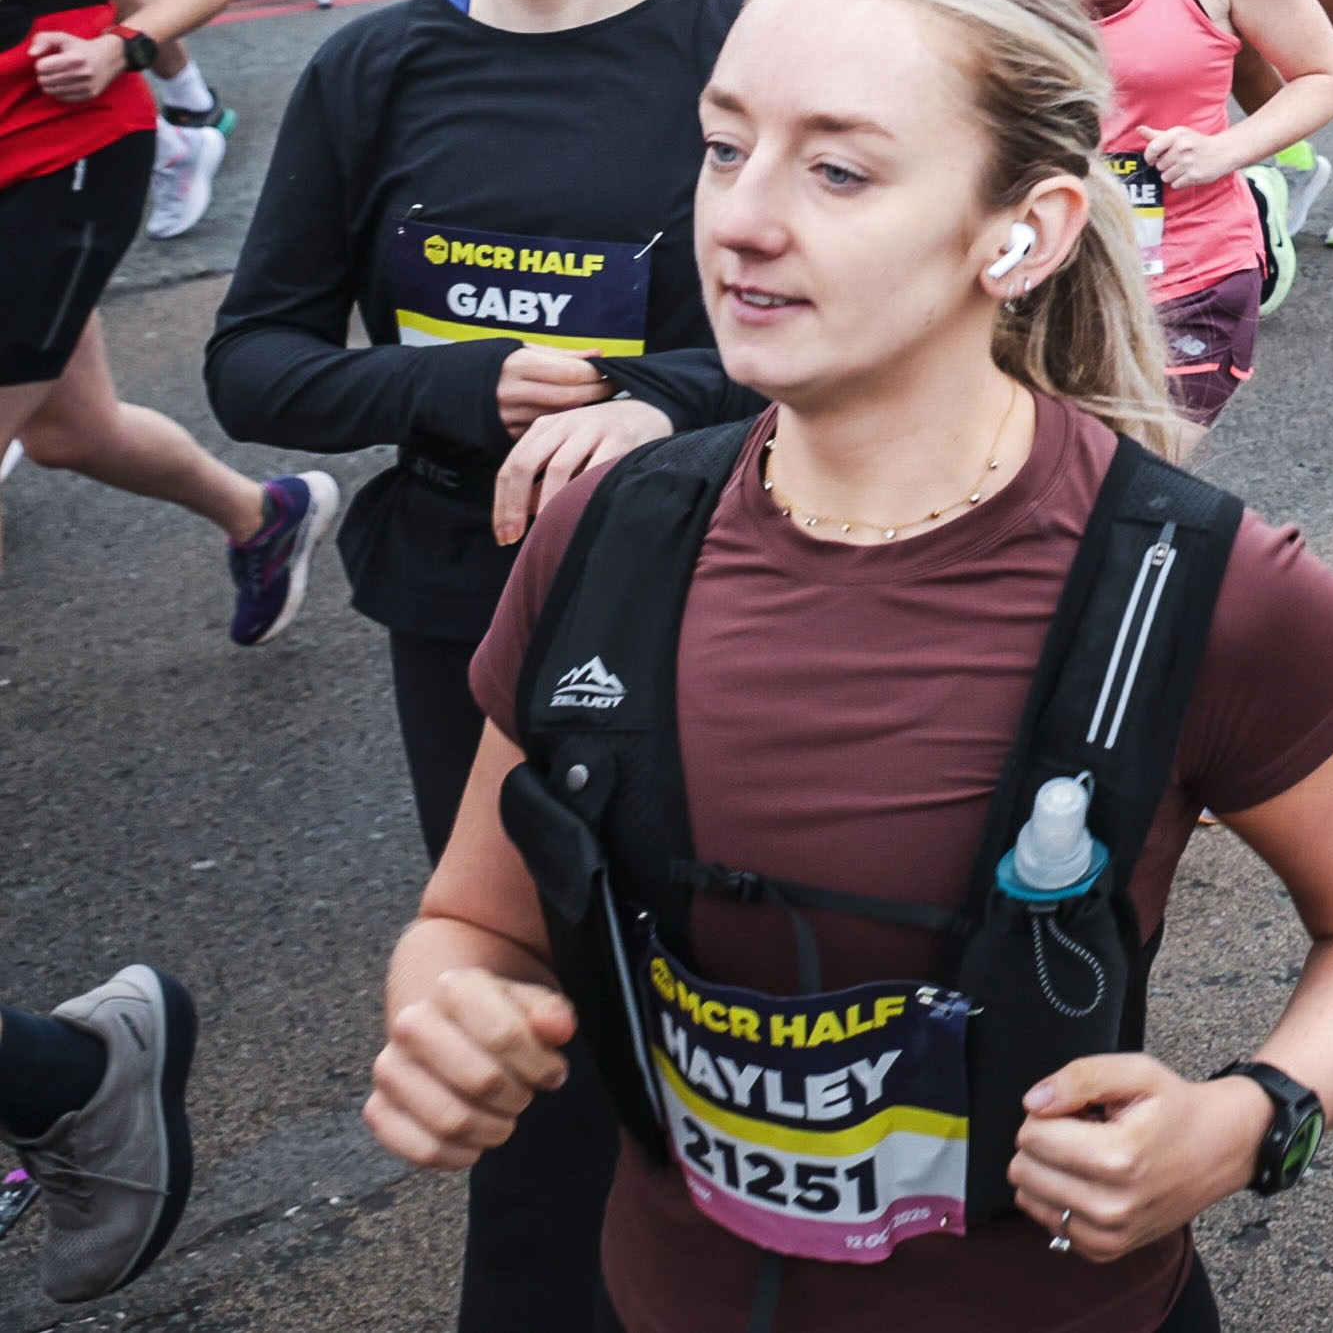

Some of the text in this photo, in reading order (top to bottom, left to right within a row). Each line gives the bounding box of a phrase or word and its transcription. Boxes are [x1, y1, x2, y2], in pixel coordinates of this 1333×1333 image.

[1122, 183, 1156, 205] LE
[451, 241, 605, 278] MCR HALF
[446, 282, 573, 327] GABY
[676, 980, 907, 1049] MCR HALF
[660, 1010, 903, 1122] HAYLEY
[682, 1115, 879, 1215] 21251
